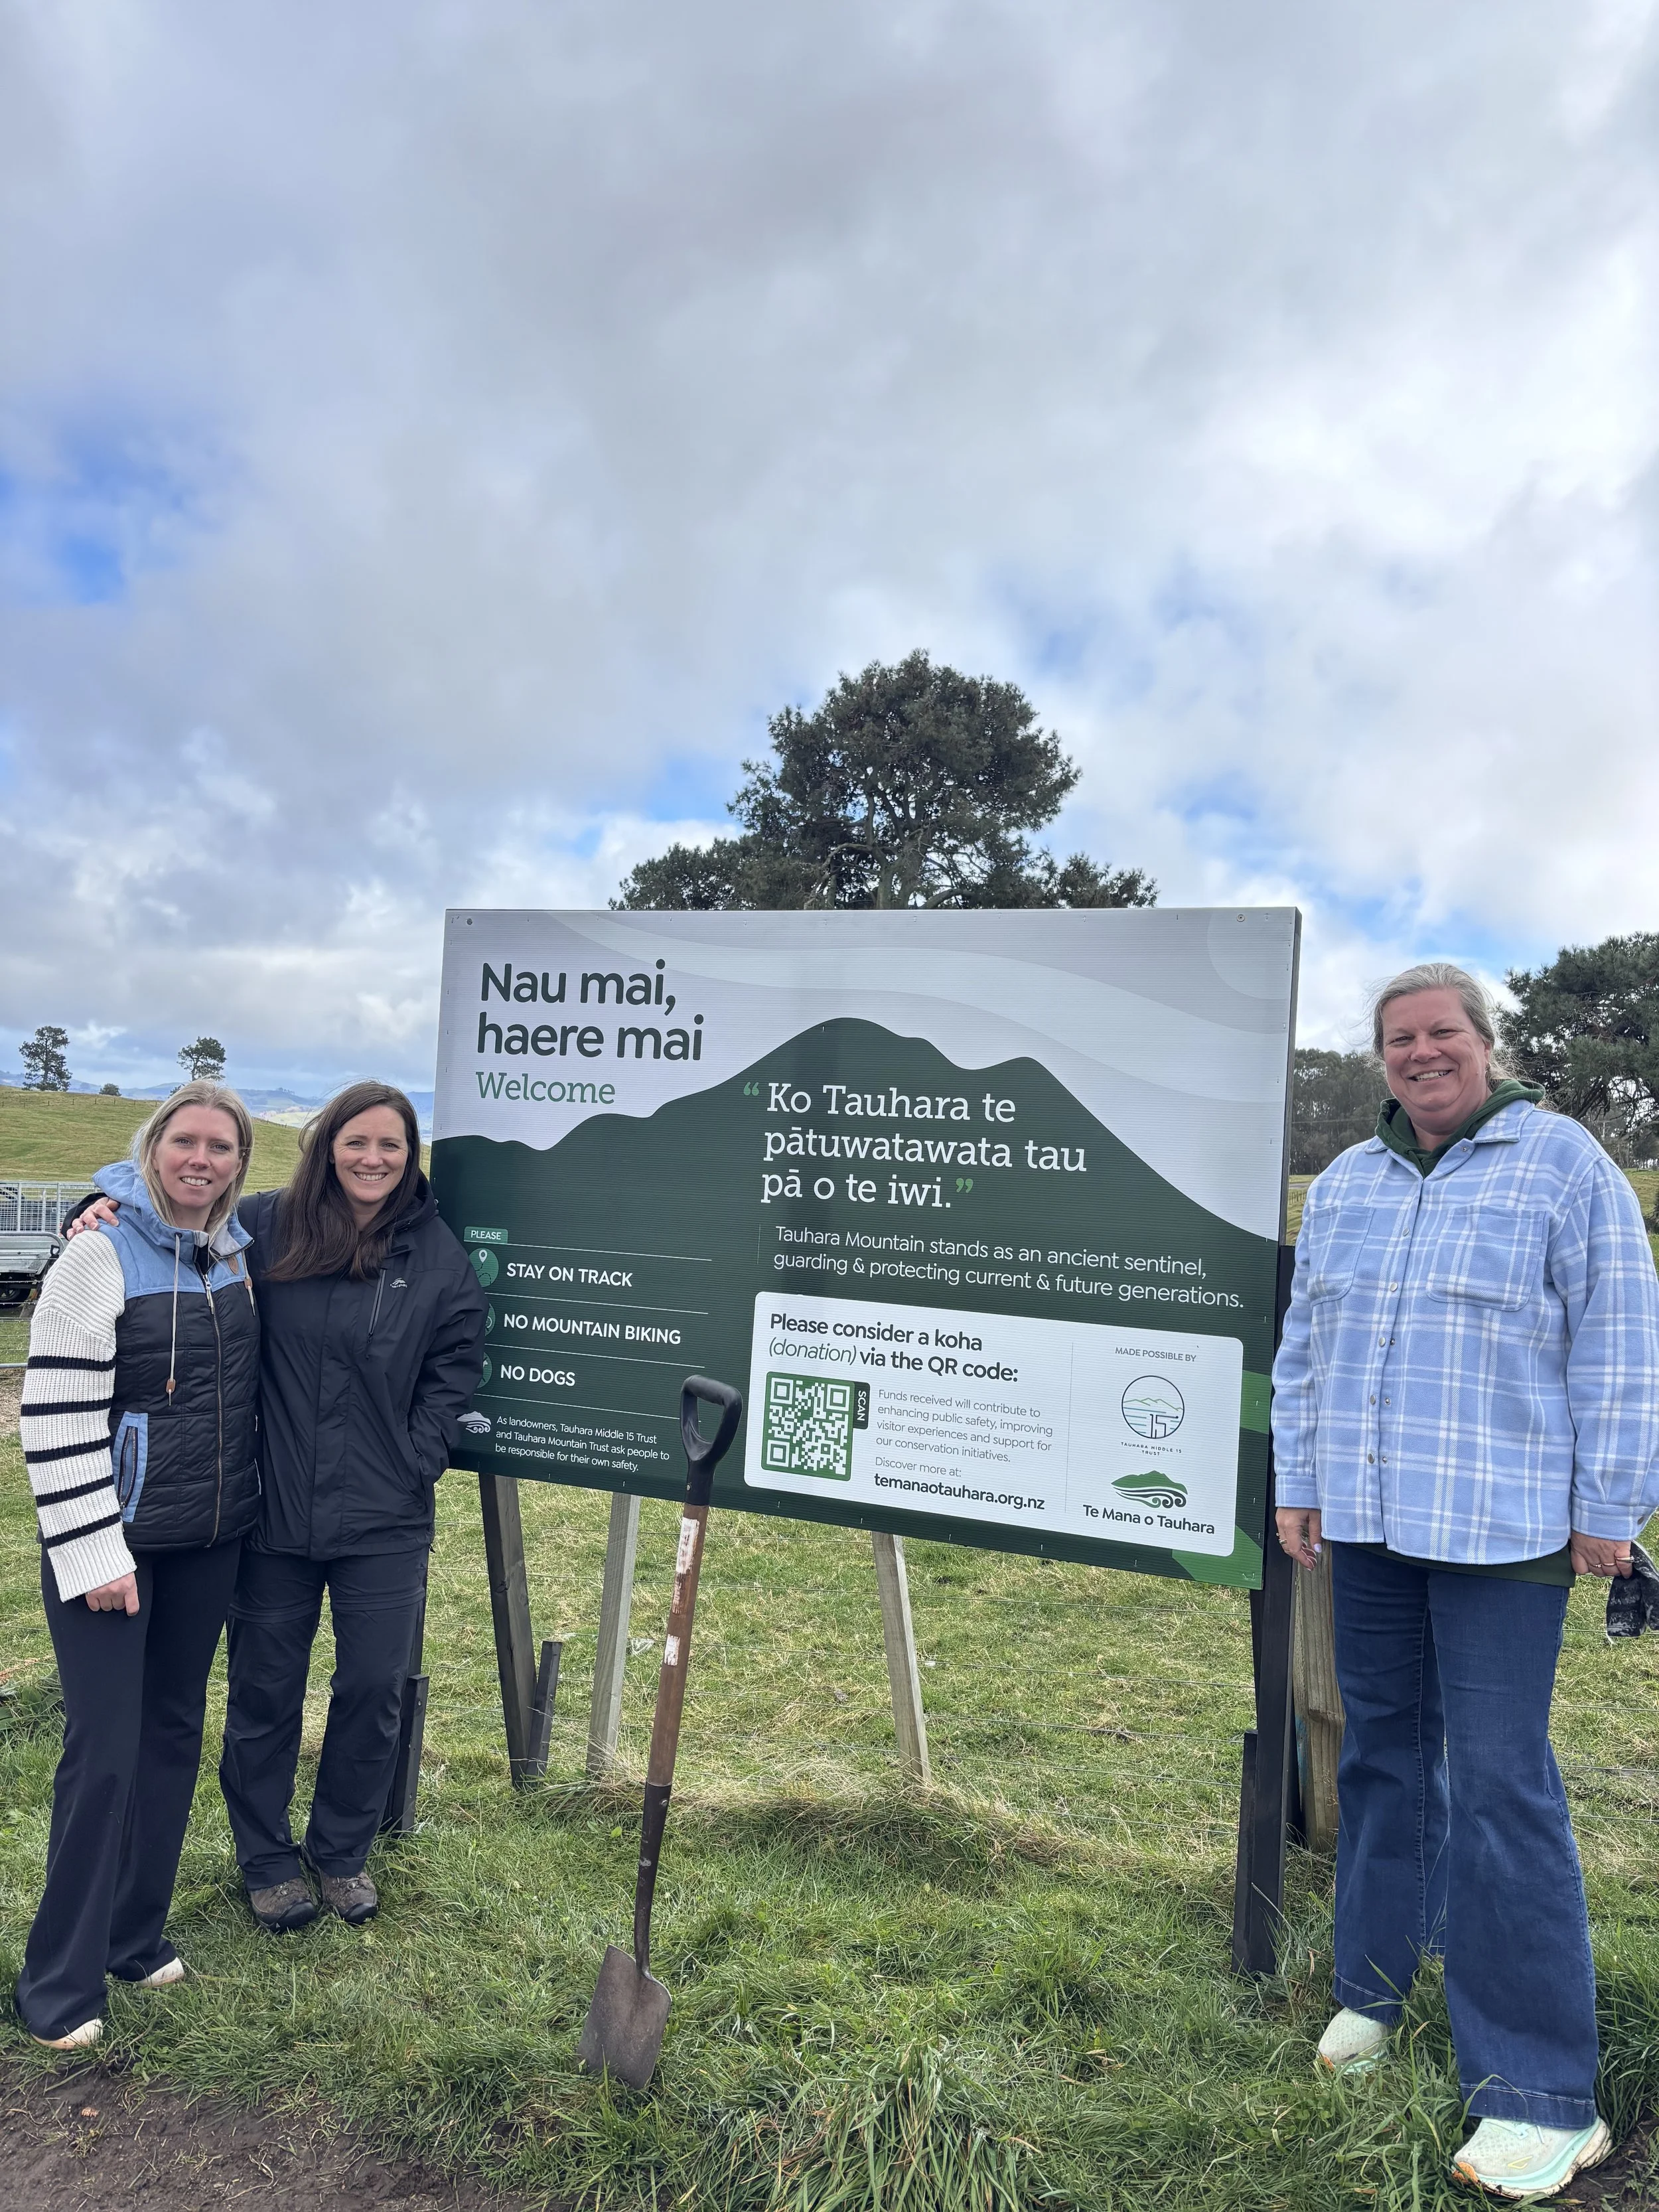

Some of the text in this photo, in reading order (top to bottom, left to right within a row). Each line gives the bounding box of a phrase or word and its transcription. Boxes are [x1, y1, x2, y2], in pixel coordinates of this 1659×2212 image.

[482, 958, 676, 1016] Nau mai,
[478, 1011, 704, 1061] haere mai
[476, 1071, 615, 1104] Welcome
[823, 1085, 970, 1121] Tauhara
[982, 1093, 1015, 1123] te
[763, 1126, 1087, 1172] pātuwatawata tau
[760, 1169, 803, 1203] pā
[814, 1178, 835, 1200] o
[847, 1174, 876, 1203] te
[470, 1230, 502, 1240] PLEASE
[776, 1226, 1207, 1279] Tauhara Mountain stands as an ancient sentinel,
[506, 1263, 633, 1287] STAY ON TRACK
[773, 1252, 1244, 1308] guarding & protecting current & future generations.
[504, 1313, 681, 1345] NO MOUNTAIN BIKING
[770, 1313, 982, 1351] Please consider a koha
[769, 1337, 1018, 1382] (donation) via the QR code:
[1115, 1347, 1141, 1356] MADE
[1142, 1350, 1183, 1361] POSSIBLE
[500, 1364, 575, 1386] NO DOGS
[857, 1390, 866, 1421] SCAN
[879, 1390, 1041, 1417] Funds received will contribute to
[497, 1416, 657, 1443] As landowners, Tauhara Middle 15 Trust
[877, 1406, 1052, 1437] enhancing public safety, improving
[877, 1420, 1052, 1451] visitor experiences and support for
[495, 1443, 639, 1471] be responsible for their own safety.
[496, 1430, 669, 1460] and Tauhara Mountain Trust ask people to
[876, 1437, 1011, 1463] our conservation initiatives.
[875, 1457, 962, 1477] Discover more at:
[874, 1473, 1045, 1509] temanaotauhara.org.nz
[1084, 1505, 1214, 1534] Te Mana o Tauhara
